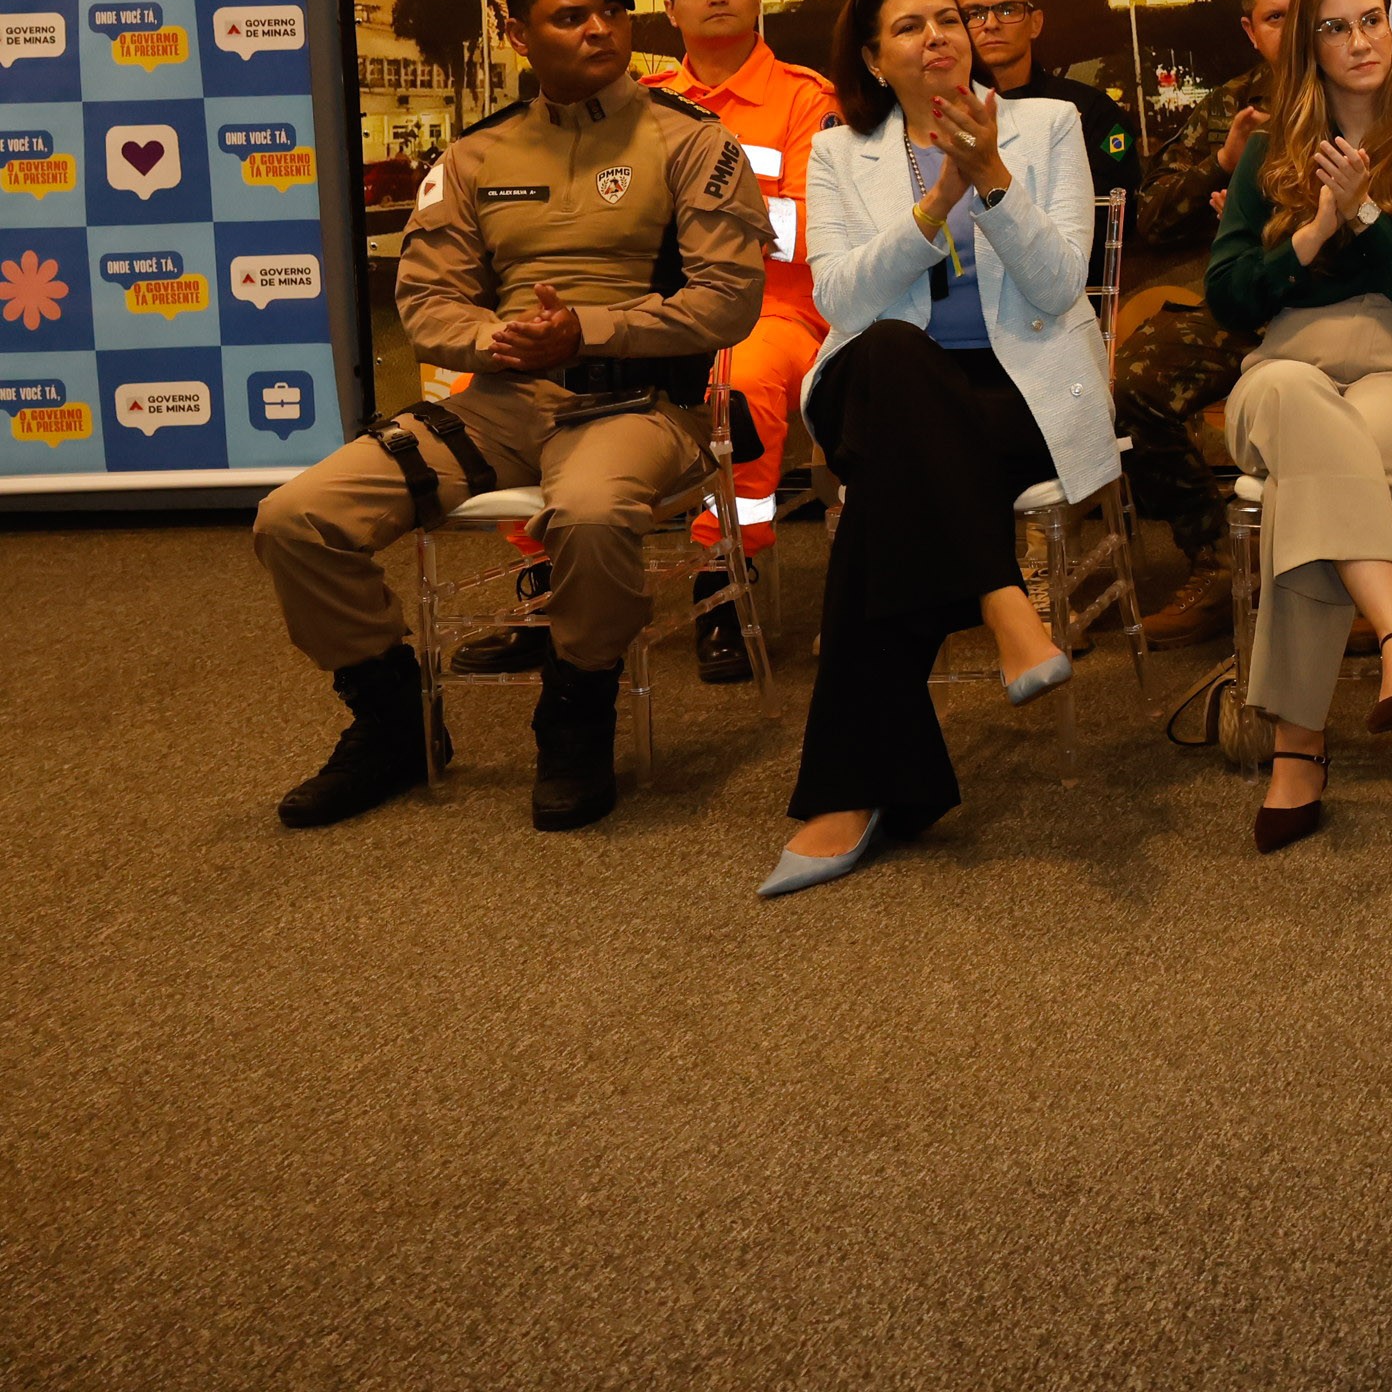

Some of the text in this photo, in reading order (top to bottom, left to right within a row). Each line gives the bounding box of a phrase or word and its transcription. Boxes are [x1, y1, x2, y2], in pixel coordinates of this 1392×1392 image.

[95, 8, 158, 25] ONDE VOCÊ TÁ,
[245, 18, 295, 27] GOVERNO
[5, 26, 55, 35] GOVERNO
[246, 28, 296, 38] DE MINAS
[6, 35, 56, 45] DE MINAS
[131, 32, 179, 45] GOVERNO
[135, 43, 180, 56] PRESENTE
[225, 129, 291, 145] ONDE VOCÊ TÁ,
[7, 136, 29, 152] VOCÊ
[32, 136, 48, 152] TÁ,
[260, 153, 311, 165] GOVERNO
[19, 161, 68, 173] GOVERNO
[265, 163, 311, 176] PRESENTE
[703, 141, 740, 199] PMMG
[23, 171, 68, 184] PRESENTE
[599, 168, 630, 182] PMMG
[107, 257, 178, 274] ONDE VOCÊ TÁ,
[260, 267, 311, 276] GOVERNO
[145, 280, 200, 293] GOVERNO
[260, 277, 312, 287] DE MINAS
[150, 291, 201, 305] PRESENTE
[19, 385, 42, 400] VOCÊ
[45, 385, 61, 401] TÁ,
[148, 394, 200, 403] GOVERNO
[30, 408, 83, 421] GOVERNO
[148, 404, 200, 414] DE MINAS
[36, 419, 84, 432] PRESENTE
